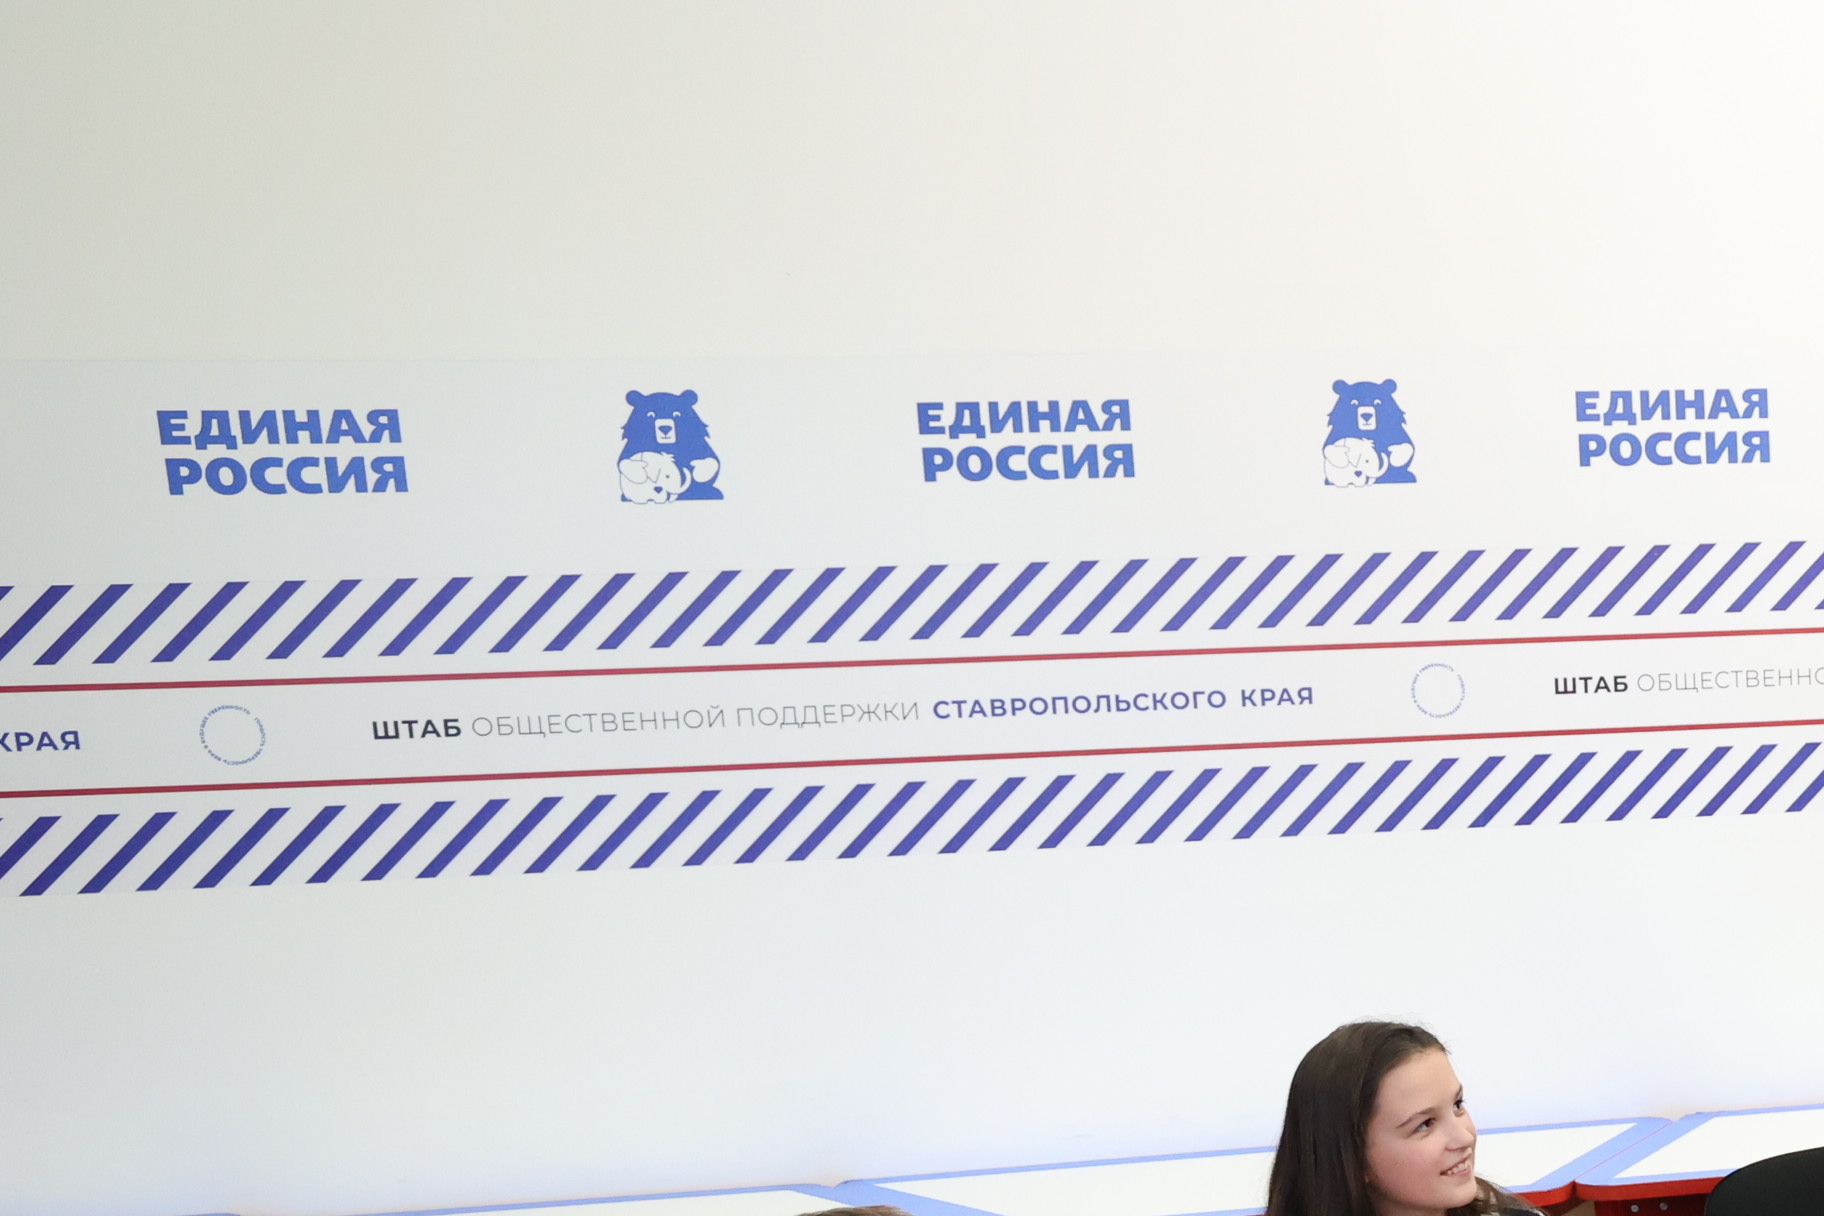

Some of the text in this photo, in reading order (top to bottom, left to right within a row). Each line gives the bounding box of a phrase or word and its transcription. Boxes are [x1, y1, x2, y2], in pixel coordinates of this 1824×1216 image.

[917, 400, 1131, 439] ЕДИНАЯ
[1576, 389, 1768, 426] ЕДИНАЯ
[157, 409, 401, 450] ЕДИНАЯ
[922, 444, 1135, 482] РОССИЯ
[1579, 431, 1770, 467] РОССИЯ
[165, 456, 408, 495] РОССИЯ
[1555, 676, 1628, 694] ШТАБ
[373, 687, 1312, 739] ШТАБ ОБЩЕСТВЕННОЙ ПОДДЕРЖКИ СТАВРОПОЛЬСКОГО КРАЯ
